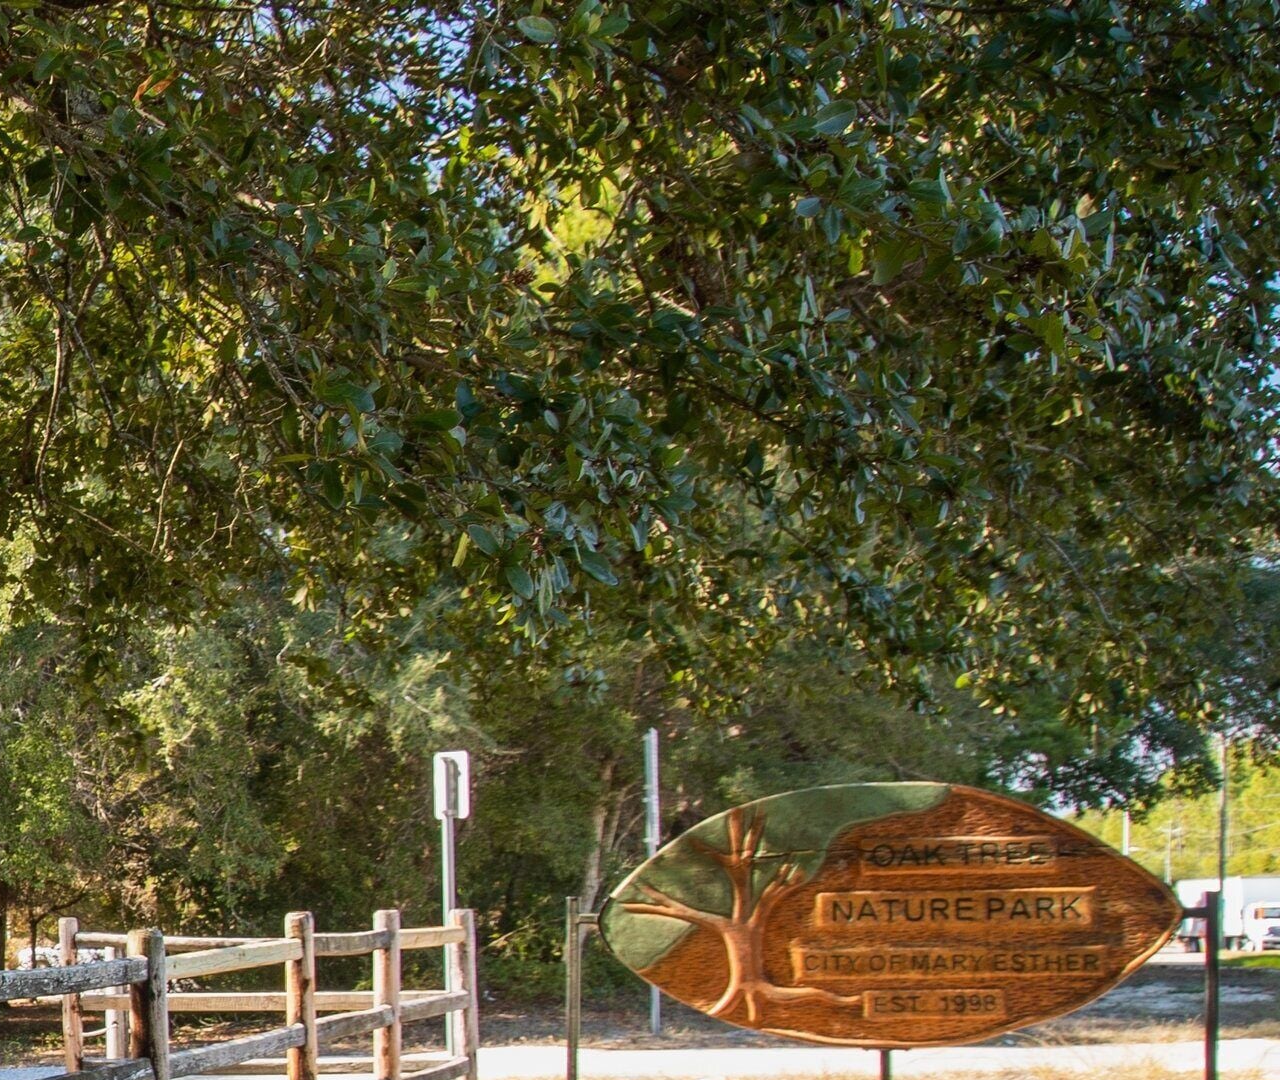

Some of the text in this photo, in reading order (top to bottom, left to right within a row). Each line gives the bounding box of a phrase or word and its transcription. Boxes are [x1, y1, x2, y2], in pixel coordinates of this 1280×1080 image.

[869, 840, 1048, 867] OAK TREE
[831, 896, 1083, 922] NATURE PARK
[804, 952, 1099, 972] CITY OF MARY ESTHER
[941, 994, 998, 1013] 1998
